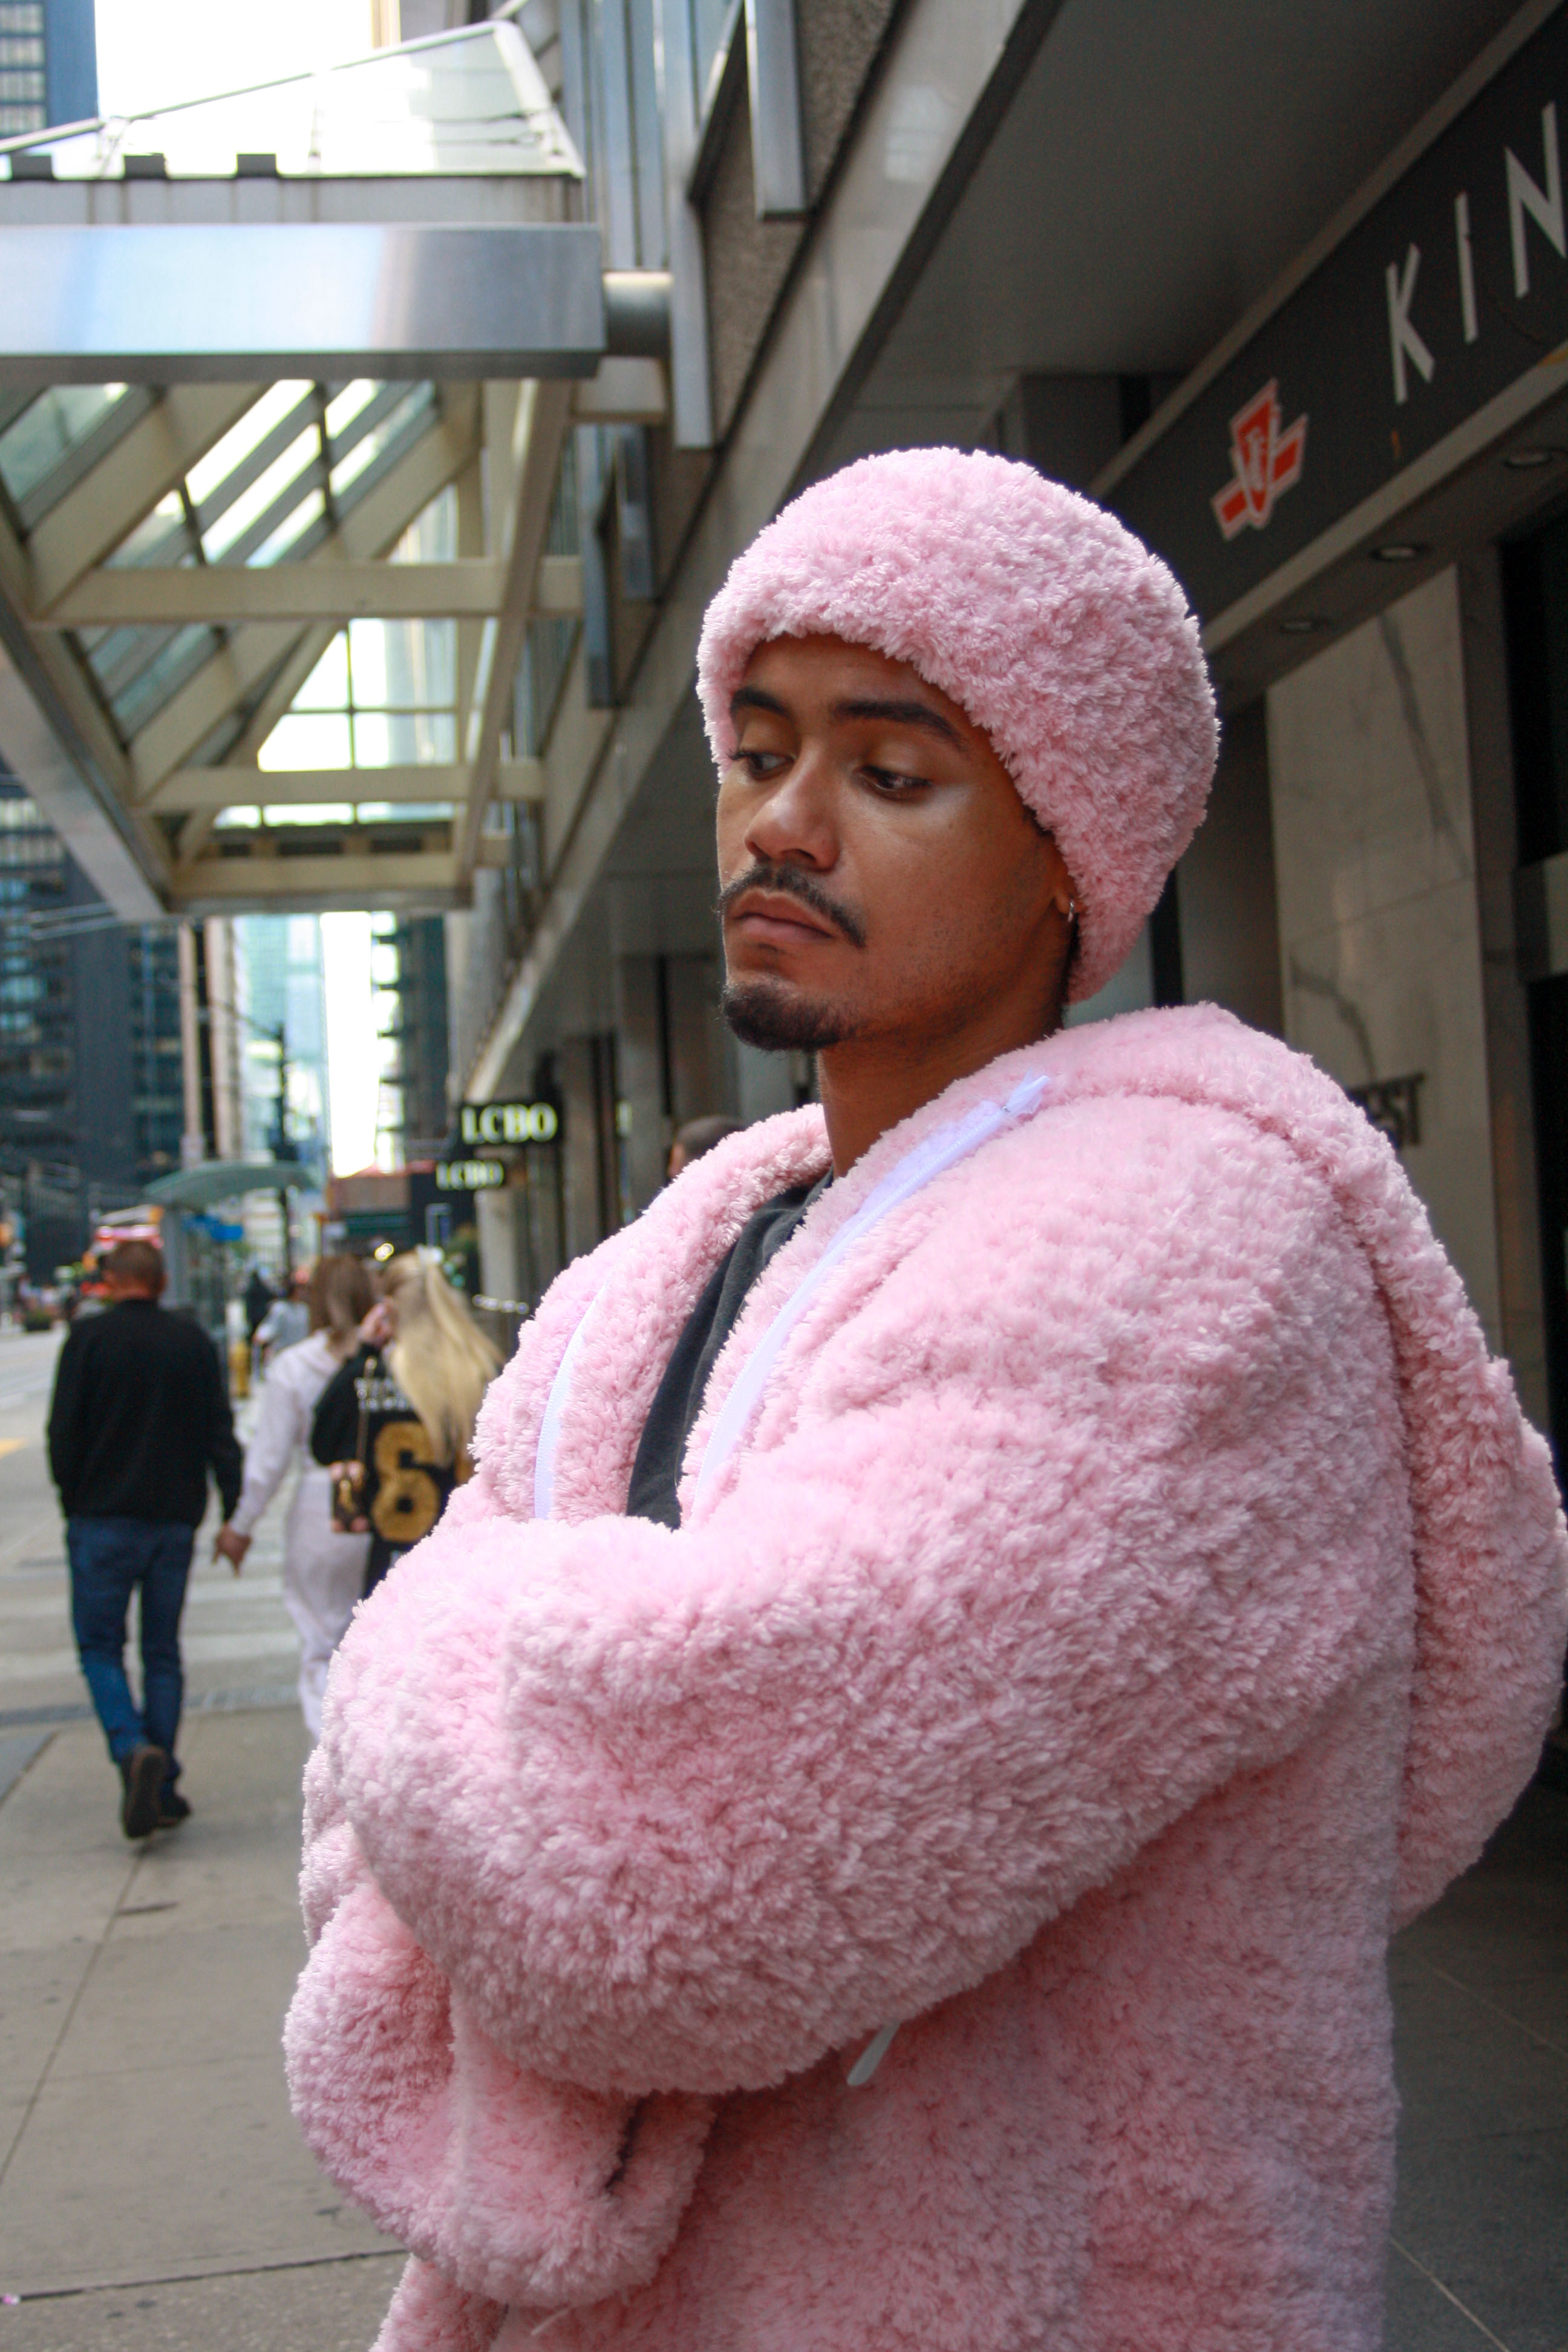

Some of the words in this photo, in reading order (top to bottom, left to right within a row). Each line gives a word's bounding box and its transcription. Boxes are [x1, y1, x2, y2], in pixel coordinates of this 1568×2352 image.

[462, 1102, 558, 1145] LCBO
[436, 1160, 505, 1191] LCBO
[371, 1420, 442, 1544] 6
